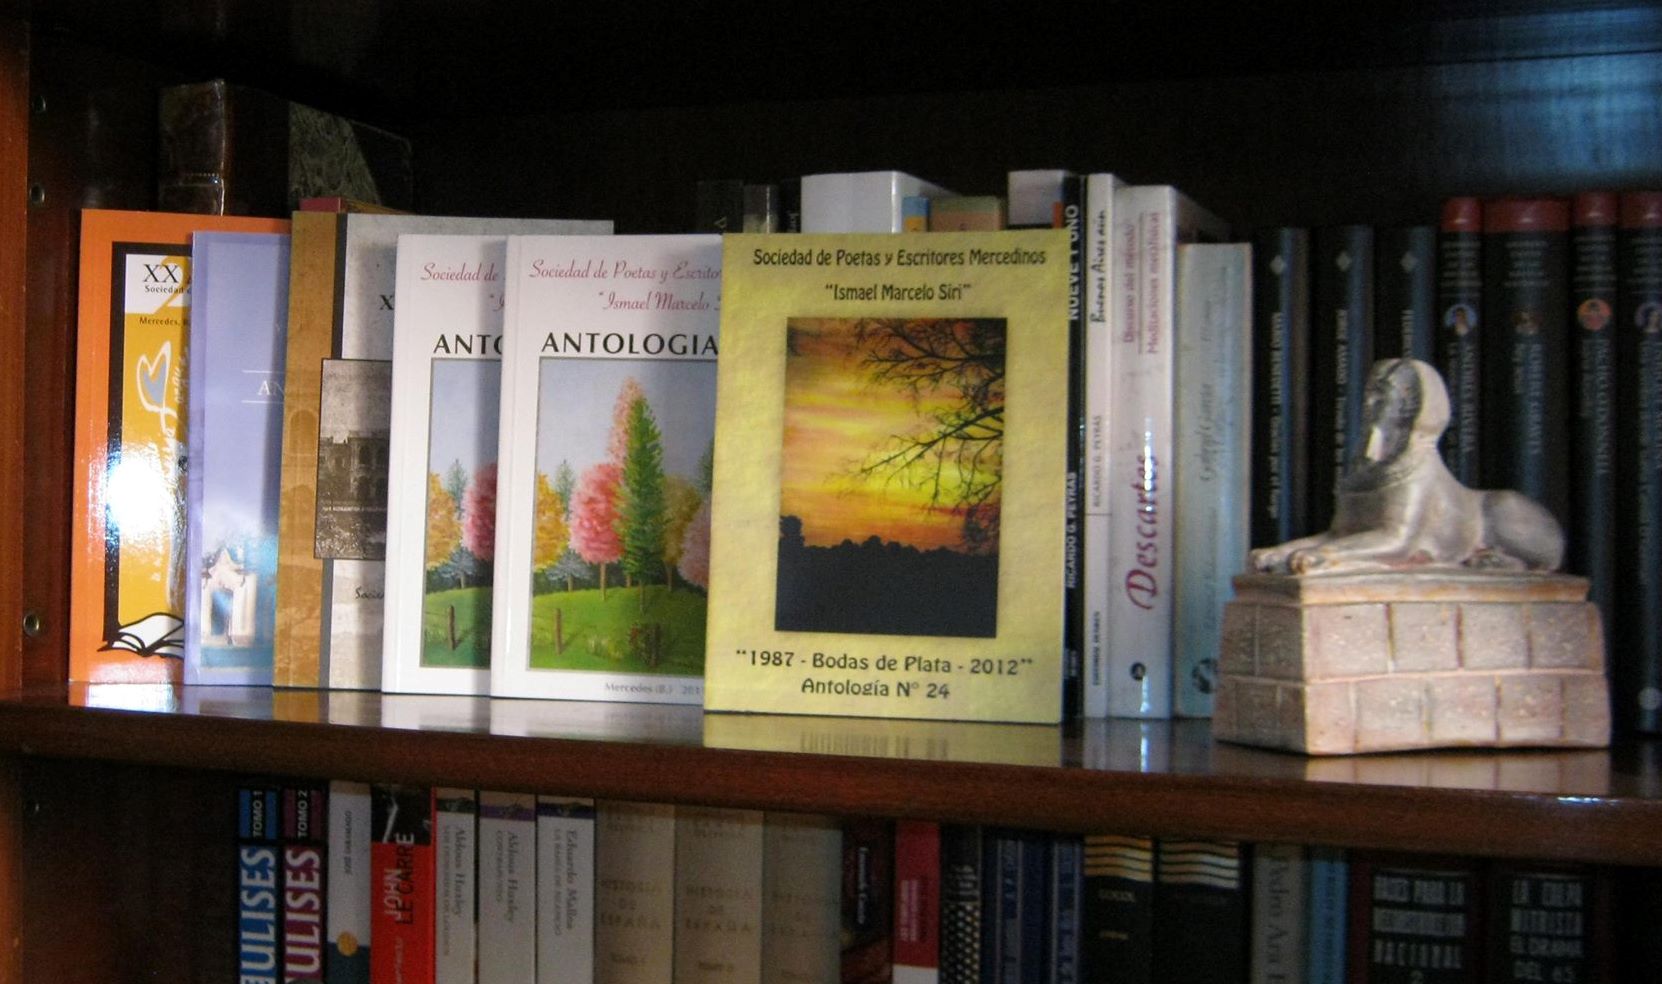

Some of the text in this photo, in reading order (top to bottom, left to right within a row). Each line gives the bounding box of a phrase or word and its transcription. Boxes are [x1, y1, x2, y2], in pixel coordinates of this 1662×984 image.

[1065, 204, 1080, 242] UNO
[143, 264, 179, 284] XX
[421, 262, 498, 282] Sociedad de
[529, 259, 590, 279] Sociedad
[593, 259, 608, 279] de
[613, 259, 657, 280] Poetas
[660, 269, 669, 284] y
[753, 248, 1046, 266] Sociedad de Poetas y Escritores Mercedinos
[1090, 239, 1106, 274] Aires
[145, 285, 183, 294] Sociedad
[655, 291, 710, 312] Marcelo
[882, 284, 934, 300] Marcelo
[1067, 263, 1080, 321] NUEVE
[1089, 277, 1106, 323] Buenos
[1121, 223, 1137, 343] Discurso del método
[1146, 278, 1161, 354] Meditaciones
[541, 332, 719, 356] ANTOLOGIA
[1092, 466, 1103, 508] RICARDO
[1066, 520, 1078, 534] G.
[1124, 454, 1160, 610] Descartes
[1066, 535, 1078, 589] RICARDO
[812, 653, 868, 671] Bodas
[875, 654, 897, 672] de
[905, 655, 951, 673] Plata
[604, 682, 654, 694] Mercedes
[801, 678, 890, 700] Antología
[926, 682, 950, 700] 24
[253, 800, 263, 838] TOMO
[297, 789, 308, 838] TOMO 2
[452, 829, 465, 916] Aldous Huxley
[503, 832, 518, 923] Aldous Huxley
[566, 829, 578, 930] Eduardo Mallea
[240, 848, 276, 971] ULISES
[285, 848, 321, 973] ULISES
[384, 868, 402, 920] JOHN
[397, 902, 413, 925] LE
